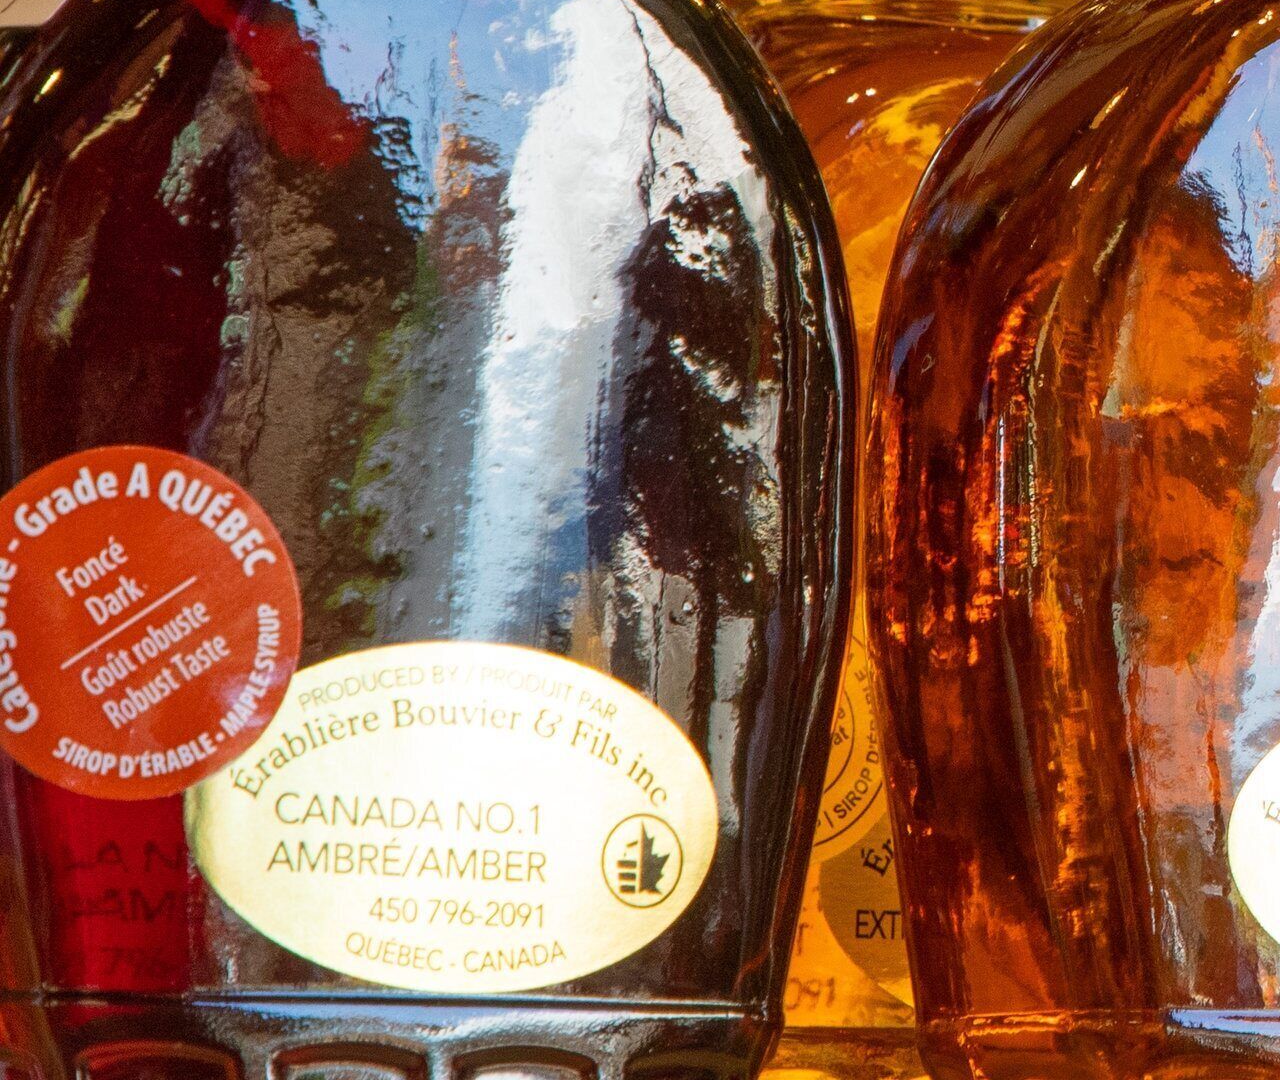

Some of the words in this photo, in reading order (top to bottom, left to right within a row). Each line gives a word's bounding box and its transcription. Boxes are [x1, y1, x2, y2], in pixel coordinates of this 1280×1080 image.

[13, 466, 119, 538] Grade
[125, 461, 150, 499] A
[158, 469, 278, 578] QUÉBEC
[54, 535, 130, 599] Foncé
[83, 575, 146, 627] Dark
[80, 650, 130, 697] Goût
[131, 601, 211, 666] robuste
[52, 736, 117, 777] SIROP
[118, 731, 219, 780] D'ÉRABLE
[219, 670, 273, 738] MAPLE
[254, 602, 281, 672] SYRUP
[101, 668, 182, 730] Robust
[170, 633, 232, 682] Taste
[297, 665, 426, 713] PRODUCED
[431, 664, 458, 685] BY
[479, 664, 574, 703] PRODUIT
[577, 689, 619, 722] PAR
[231, 704, 381, 800] Érablière
[390, 698, 522, 731] Bouvier
[532, 707, 564, 739] &
[567, 716, 625, 768] Fils
[627, 752, 669, 808] inc
[274, 792, 444, 831] CANADA
[455, 800, 542, 836] NO.1
[833, 768, 875, 820] SIROP
[266, 837, 548, 884] AMBRÉ/AMBER
[368, 896, 420, 924] 450
[428, 901, 546, 930] 796-2091
[344, 928, 444, 973] QUÉBEC
[462, 940, 568, 976] CANADA
